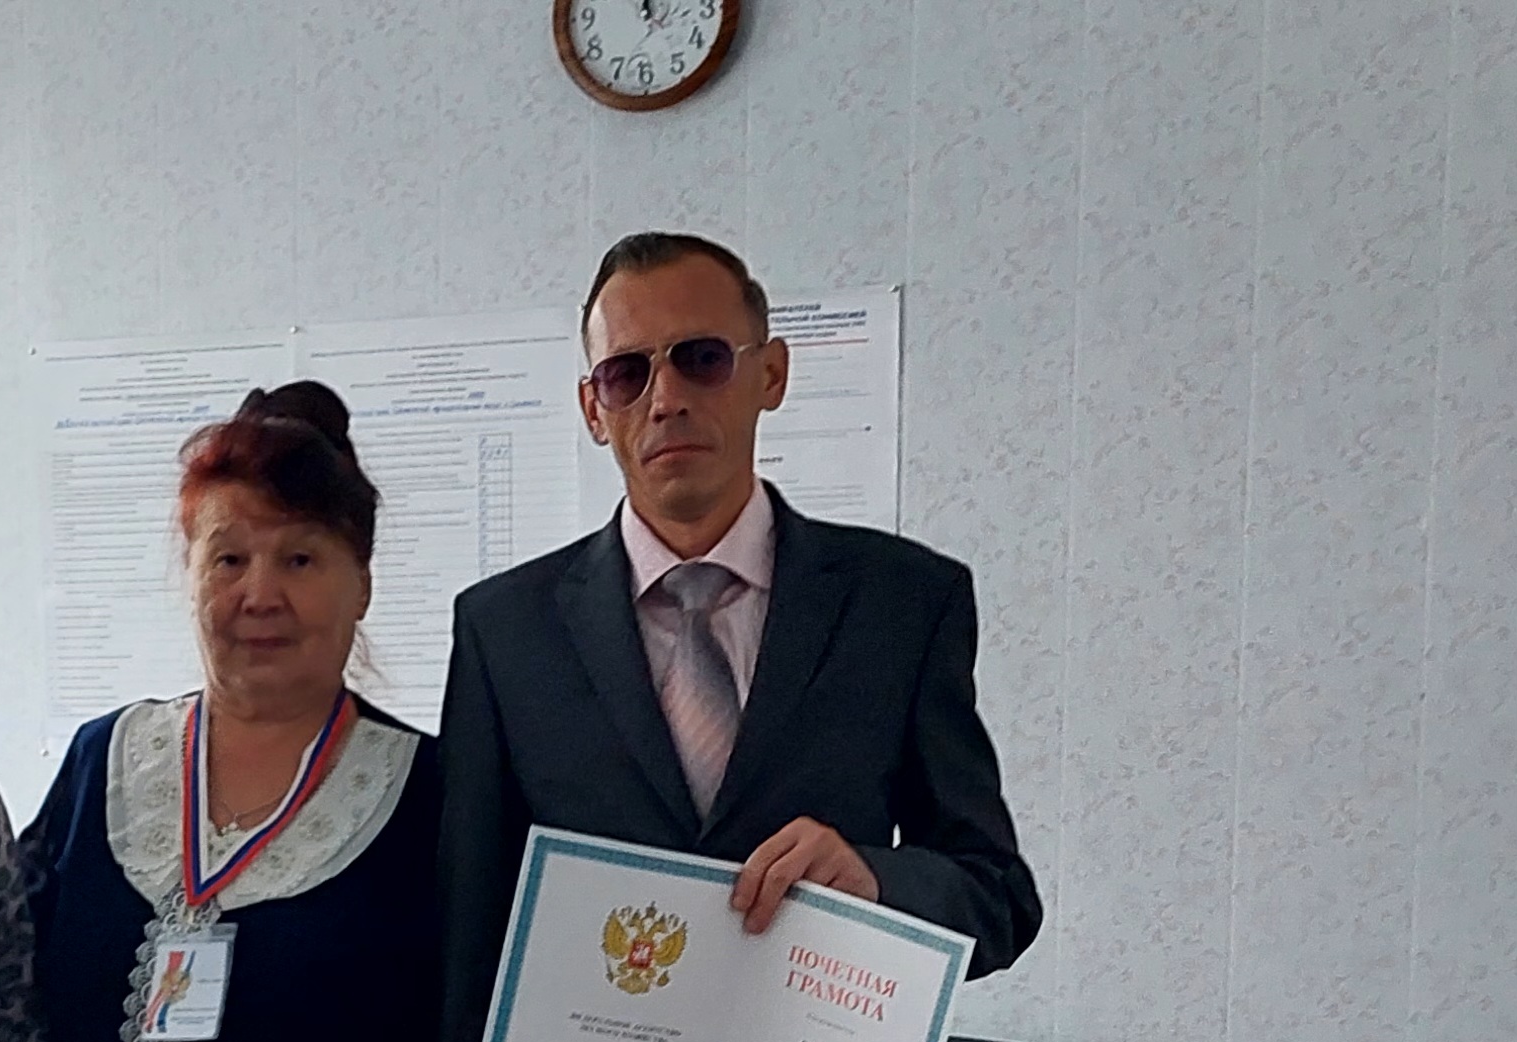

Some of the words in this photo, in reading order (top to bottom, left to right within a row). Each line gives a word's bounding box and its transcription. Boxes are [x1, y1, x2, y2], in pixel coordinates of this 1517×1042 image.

[581, 7, 595, 31] 9
[586, 36, 603, 60] 8
[688, 25, 705, 49] 4
[610, 57, 625, 80] 7
[637, 61, 654, 85] 6
[670, 52, 685, 74] 5
[788, 945, 898, 998] ПОЧЕТНАЯ
[785, 970, 884, 1021] ГРАМОТА
